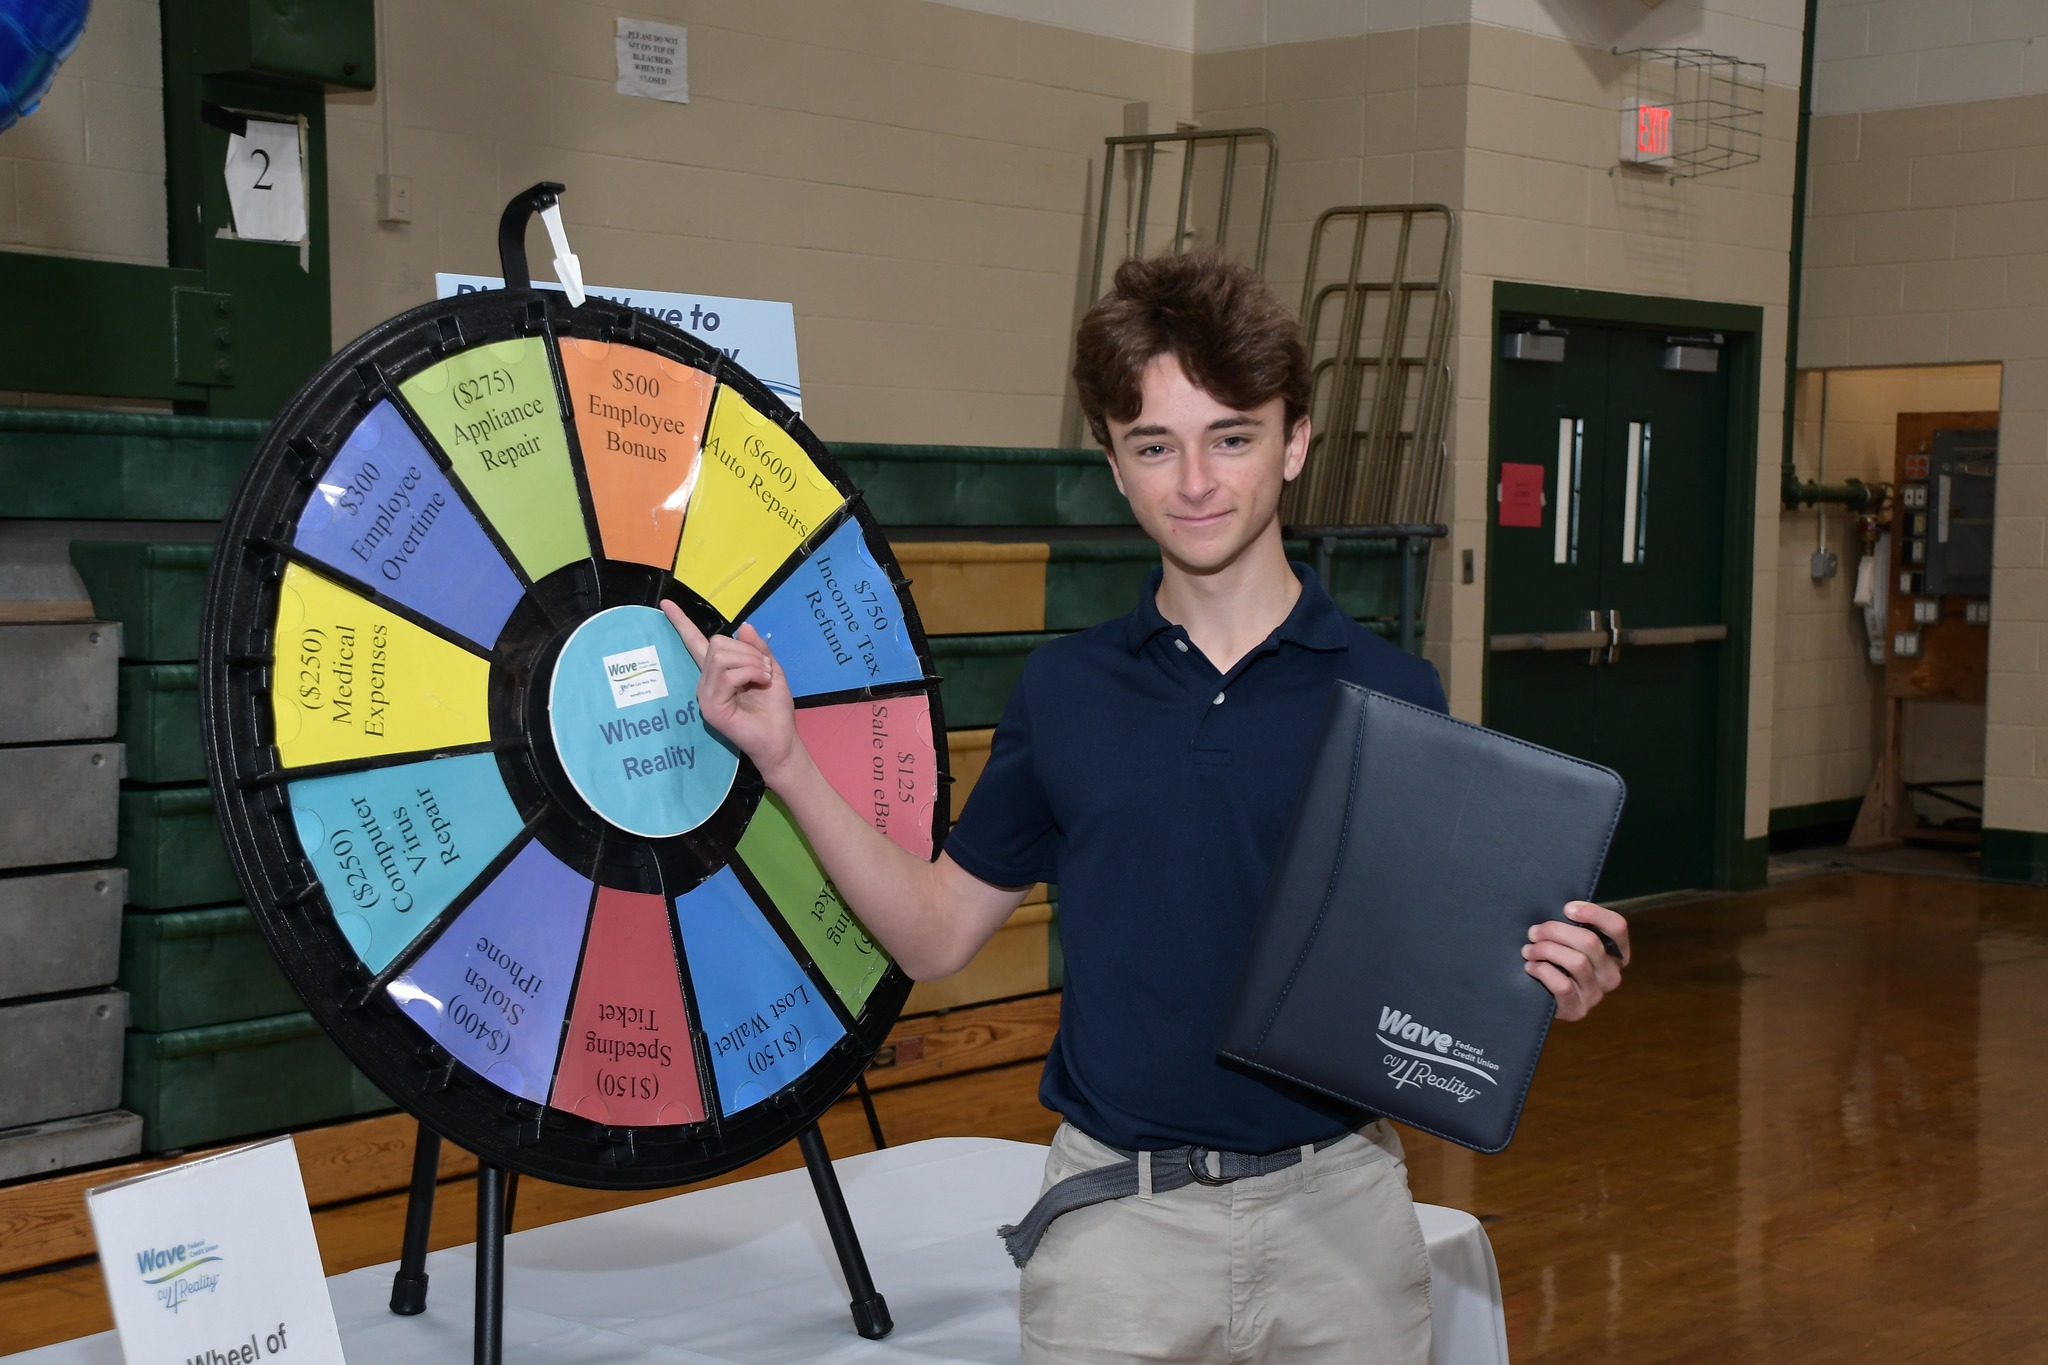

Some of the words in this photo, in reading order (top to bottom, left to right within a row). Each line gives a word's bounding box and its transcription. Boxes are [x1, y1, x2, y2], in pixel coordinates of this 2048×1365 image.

[628, 31, 652, 41] PLEASE
[665, 37, 678, 45] NOT
[632, 53, 673, 65] BLEACHERS
[653, 45, 666, 53] TOP
[667, 47, 675, 55] OF
[635, 63, 655, 72] WHEN
[656, 66, 663, 74] IT
[640, 75, 667, 85] CLOSED
[1638, 104, 1671, 155] EXIT
[250, 148, 273, 190] 2
[690, 304, 721, 332] to
[452, 368, 515, 411] ($275)
[612, 369, 660, 398] $500
[454, 398, 545, 446] Appliance
[588, 394, 685, 435] Employee
[480, 435, 541, 472] Repair
[606, 430, 667, 463] Bonus
[743, 434, 798, 493] ($600)
[339, 462, 381, 517] $300
[705, 436, 746, 479] Auto
[748, 474, 809, 538] Repairs
[351, 466, 422, 564] Employee
[381, 491, 446, 581] Overtime
[805, 588, 853, 666] Refund
[817, 556, 859, 632] Income
[858, 635, 881, 677] Tax
[854, 580, 888, 631] $750
[300, 628, 328, 710] ($250)
[333, 625, 356, 725] Medical
[365, 624, 390, 738] Expenses
[608, 662, 637, 677] Wave
[599, 708, 670, 745] Wheel
[675, 700, 696, 726] of
[872, 704, 888, 749] Sale
[622, 746, 696, 780] Reality
[873, 756, 884, 781] on
[897, 751, 915, 804] $125
[393, 806, 428, 876] Virus
[417, 788, 461, 867] Repair
[329, 829, 381, 909] ($250)
[351, 796, 414, 913] Computer
[810, 880, 836, 922] cket
[477, 936, 544, 999] iPhone
[464, 967, 526, 1026] Stolen
[599, 1003, 659, 1031] Ticket
[770, 984, 810, 1019] Lost
[447, 994, 511, 1056] ($400)
[714, 1013, 771, 1058] Wallet
[1378, 1005, 1453, 1054] Wave
[585, 1031, 672, 1067] Speeding
[748, 1023, 802, 1075] ($150)
[1452, 1049, 1476, 1063] Credit
[1476, 1057, 1499, 1071] Union
[1455, 1040, 1484, 1056] Federal
[596, 1068, 659, 1100] ($150)
[137, 1244, 187, 1275] Wave
[266, 1322, 288, 1354] of
